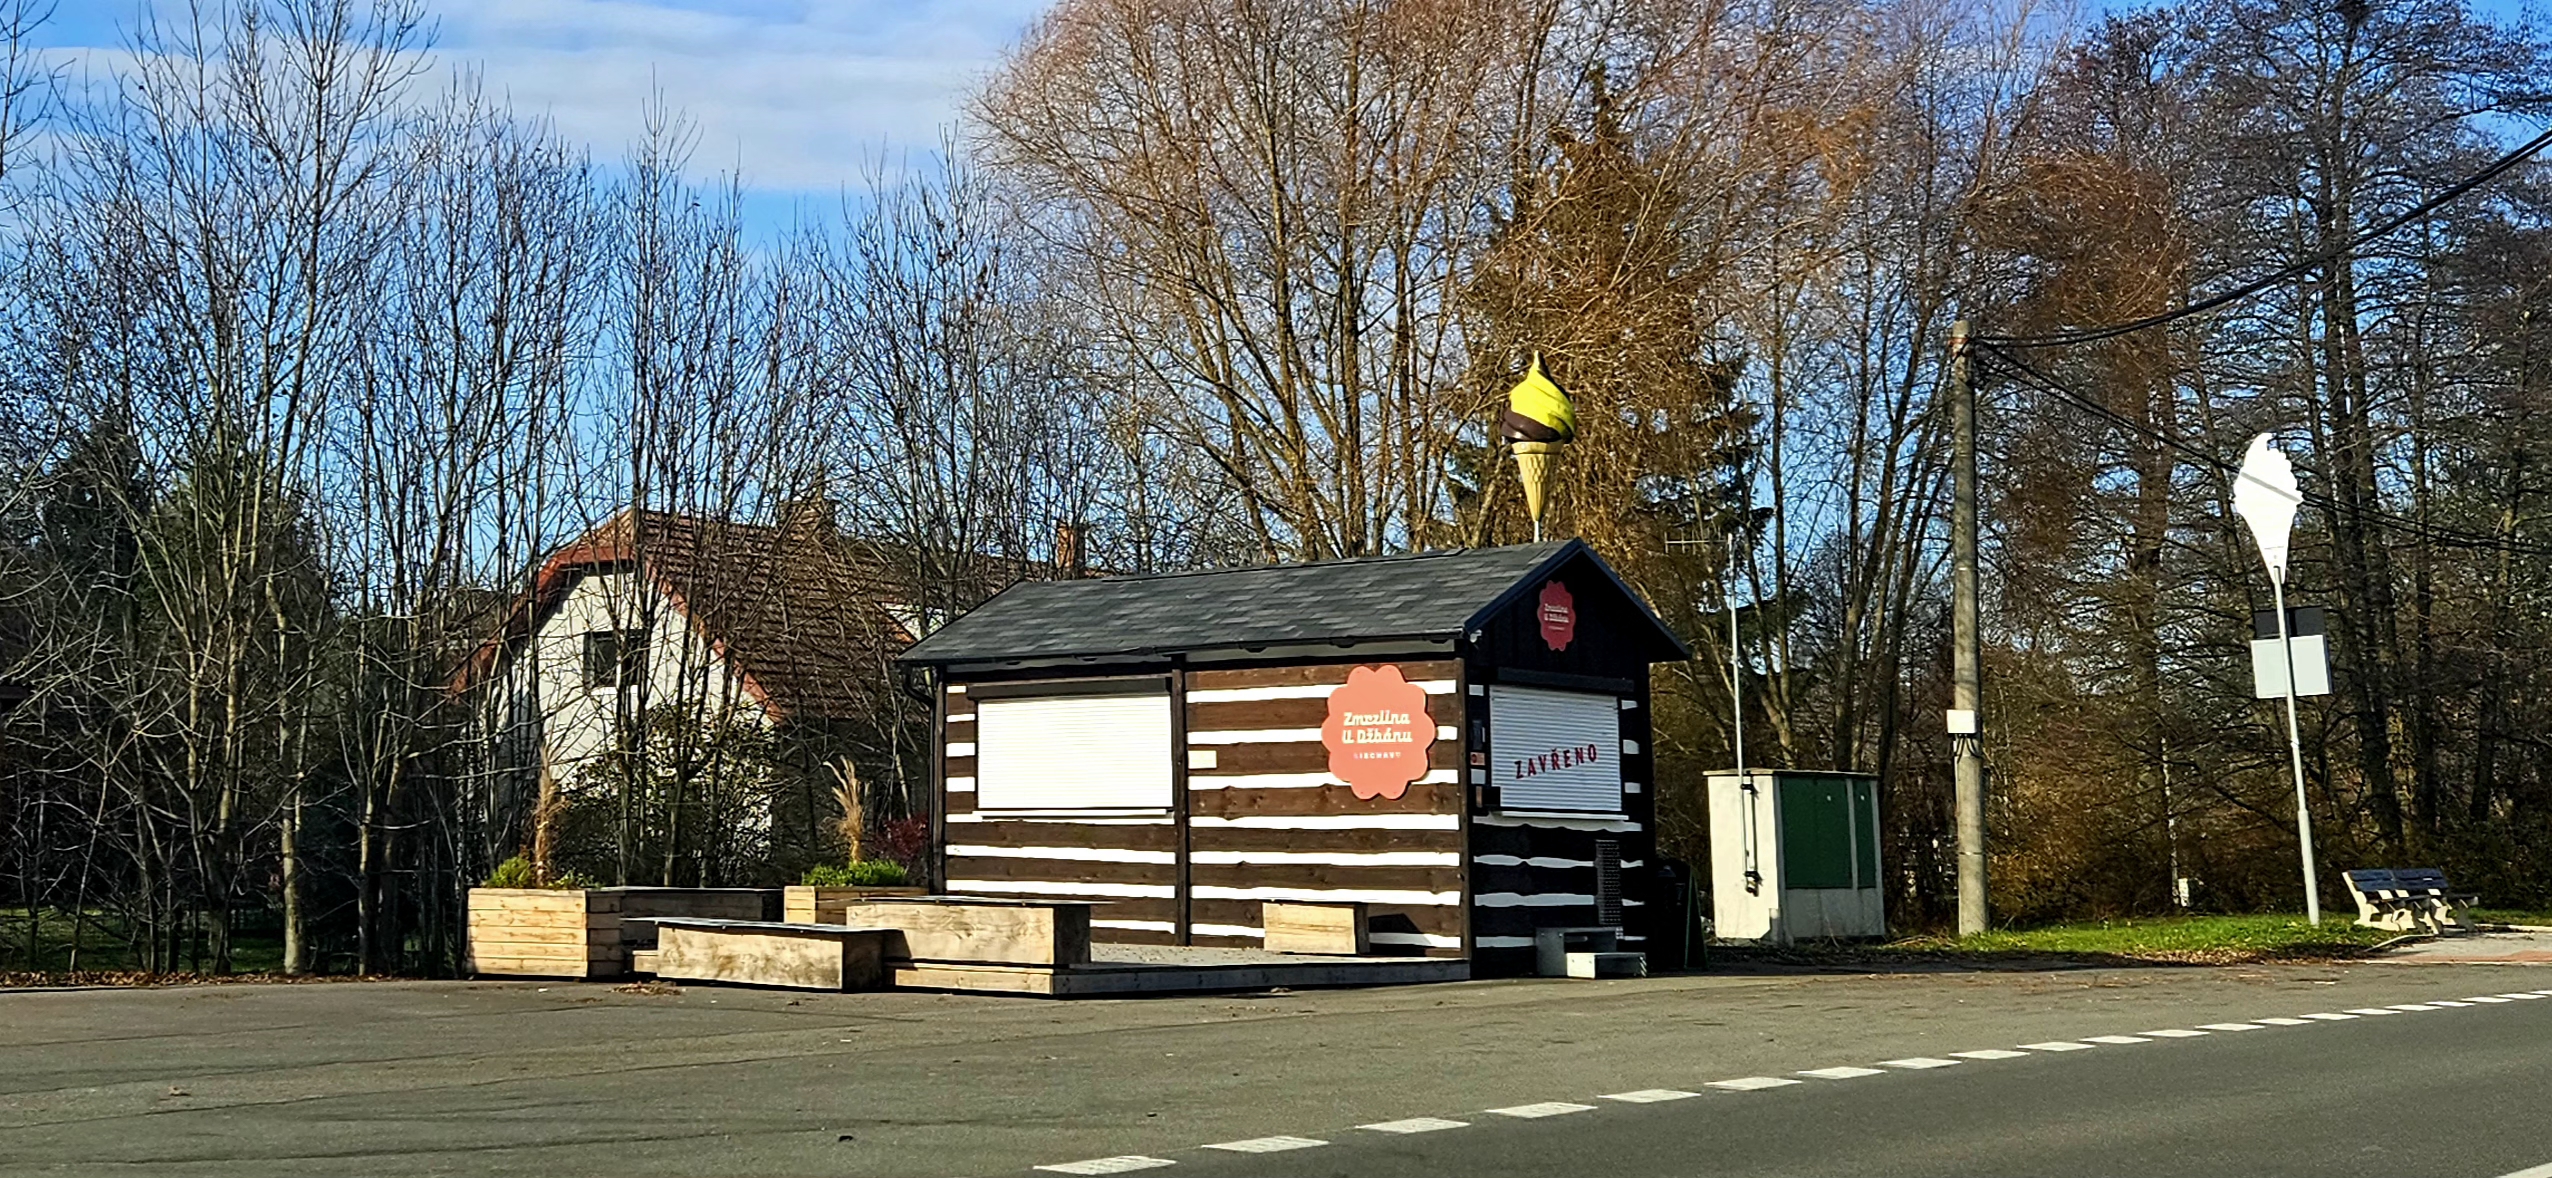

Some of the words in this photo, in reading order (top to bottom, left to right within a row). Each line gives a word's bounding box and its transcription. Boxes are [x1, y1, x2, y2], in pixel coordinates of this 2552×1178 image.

[1343, 710, 1411, 726] Zmrzlina
[1342, 729, 1355, 744] U
[1357, 727, 1413, 744] Džbánu
[1514, 744, 1597, 779] ZAVŘENO
